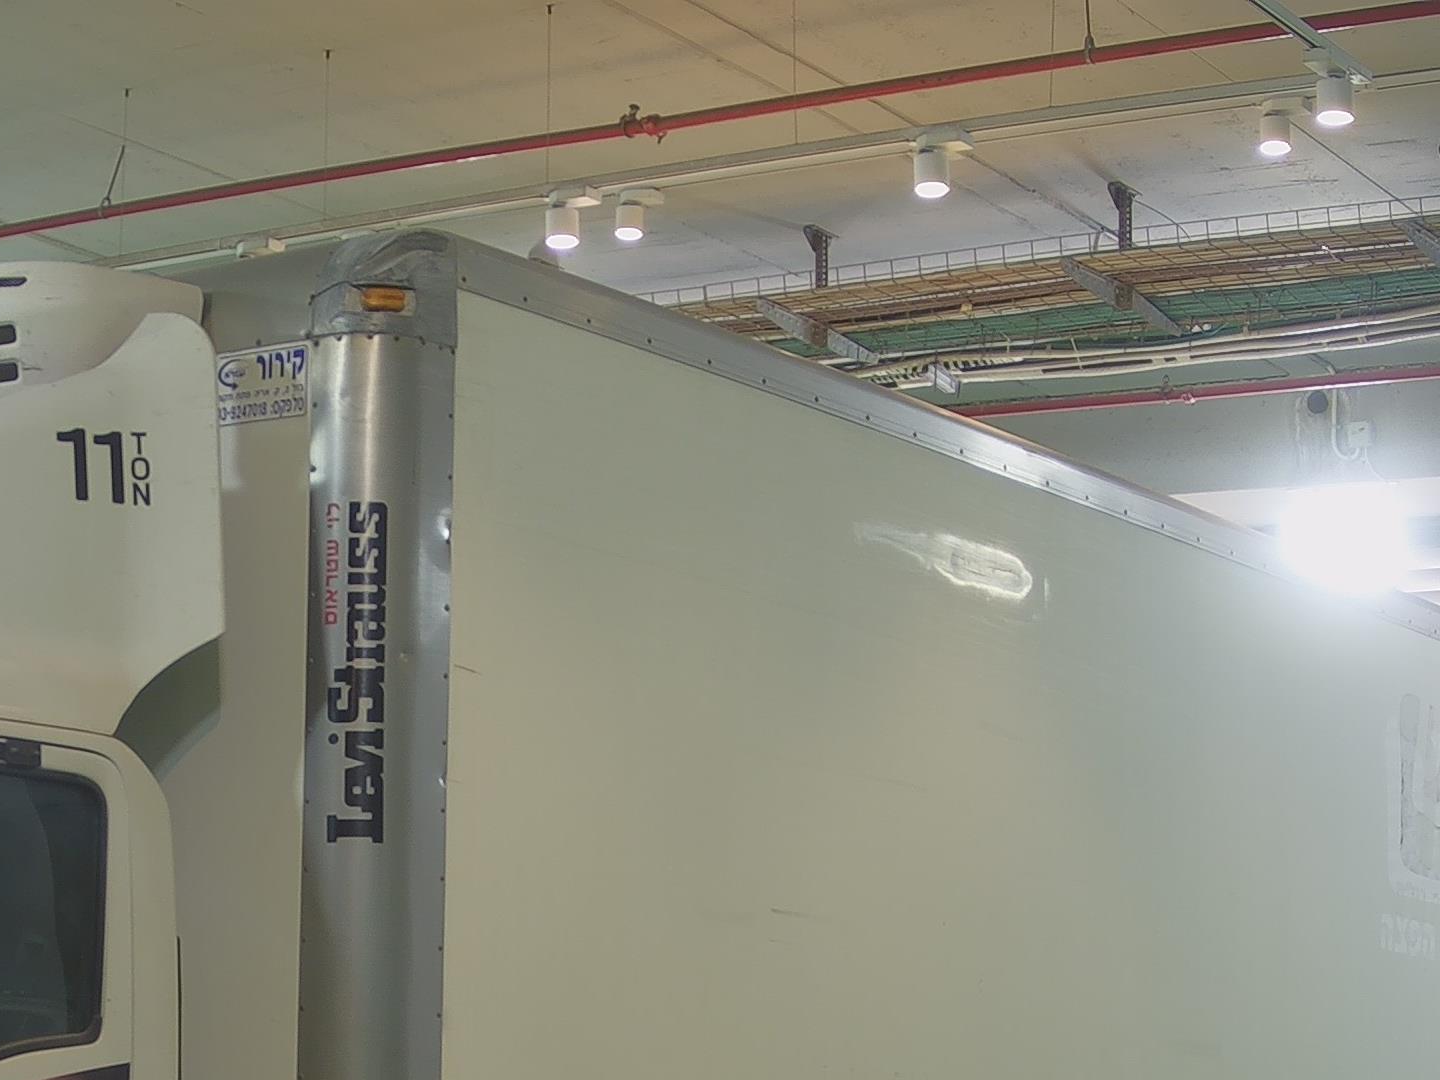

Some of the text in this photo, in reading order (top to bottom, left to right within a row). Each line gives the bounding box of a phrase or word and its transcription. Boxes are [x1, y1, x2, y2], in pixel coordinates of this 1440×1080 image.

[256, 349, 305, 380] קירור
[56, 428, 151, 506] 11 TON
[323, 502, 341, 627] לוי שטראוס
